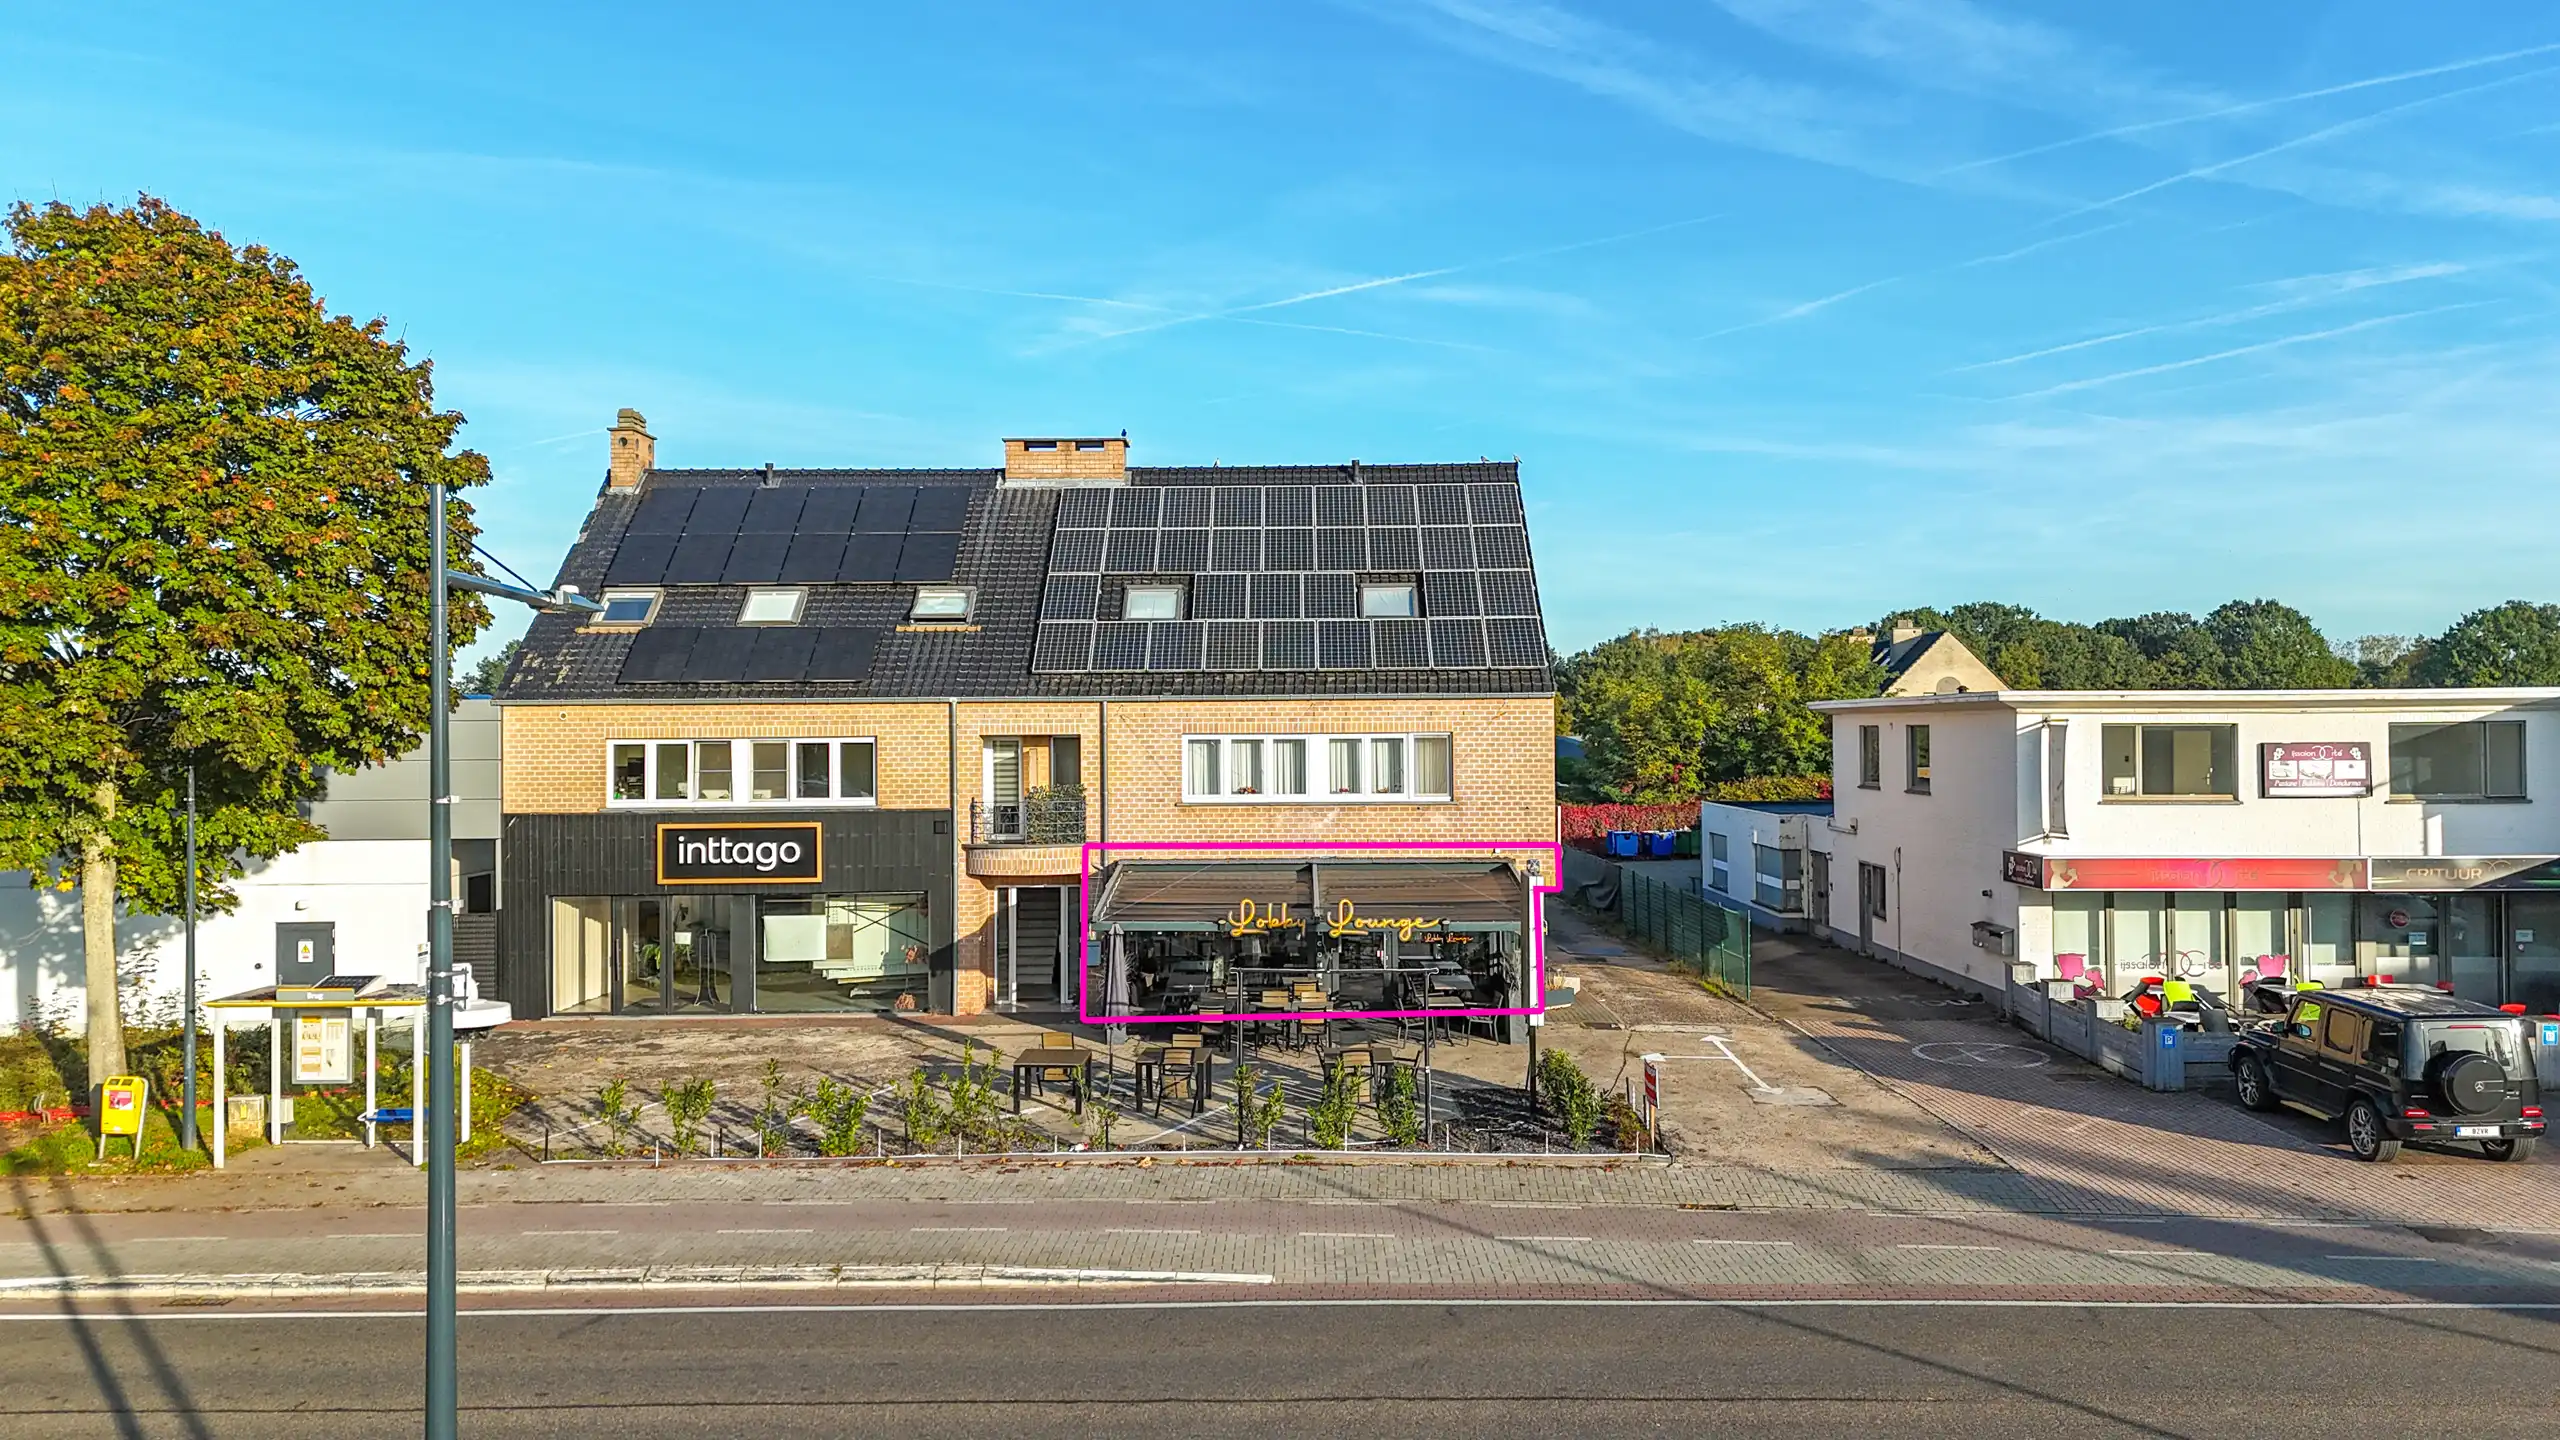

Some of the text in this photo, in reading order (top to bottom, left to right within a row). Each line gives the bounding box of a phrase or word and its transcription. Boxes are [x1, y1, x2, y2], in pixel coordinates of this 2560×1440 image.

[678, 835, 801, 872] inttago
[1228, 898, 1440, 942] Lobby Lounge
